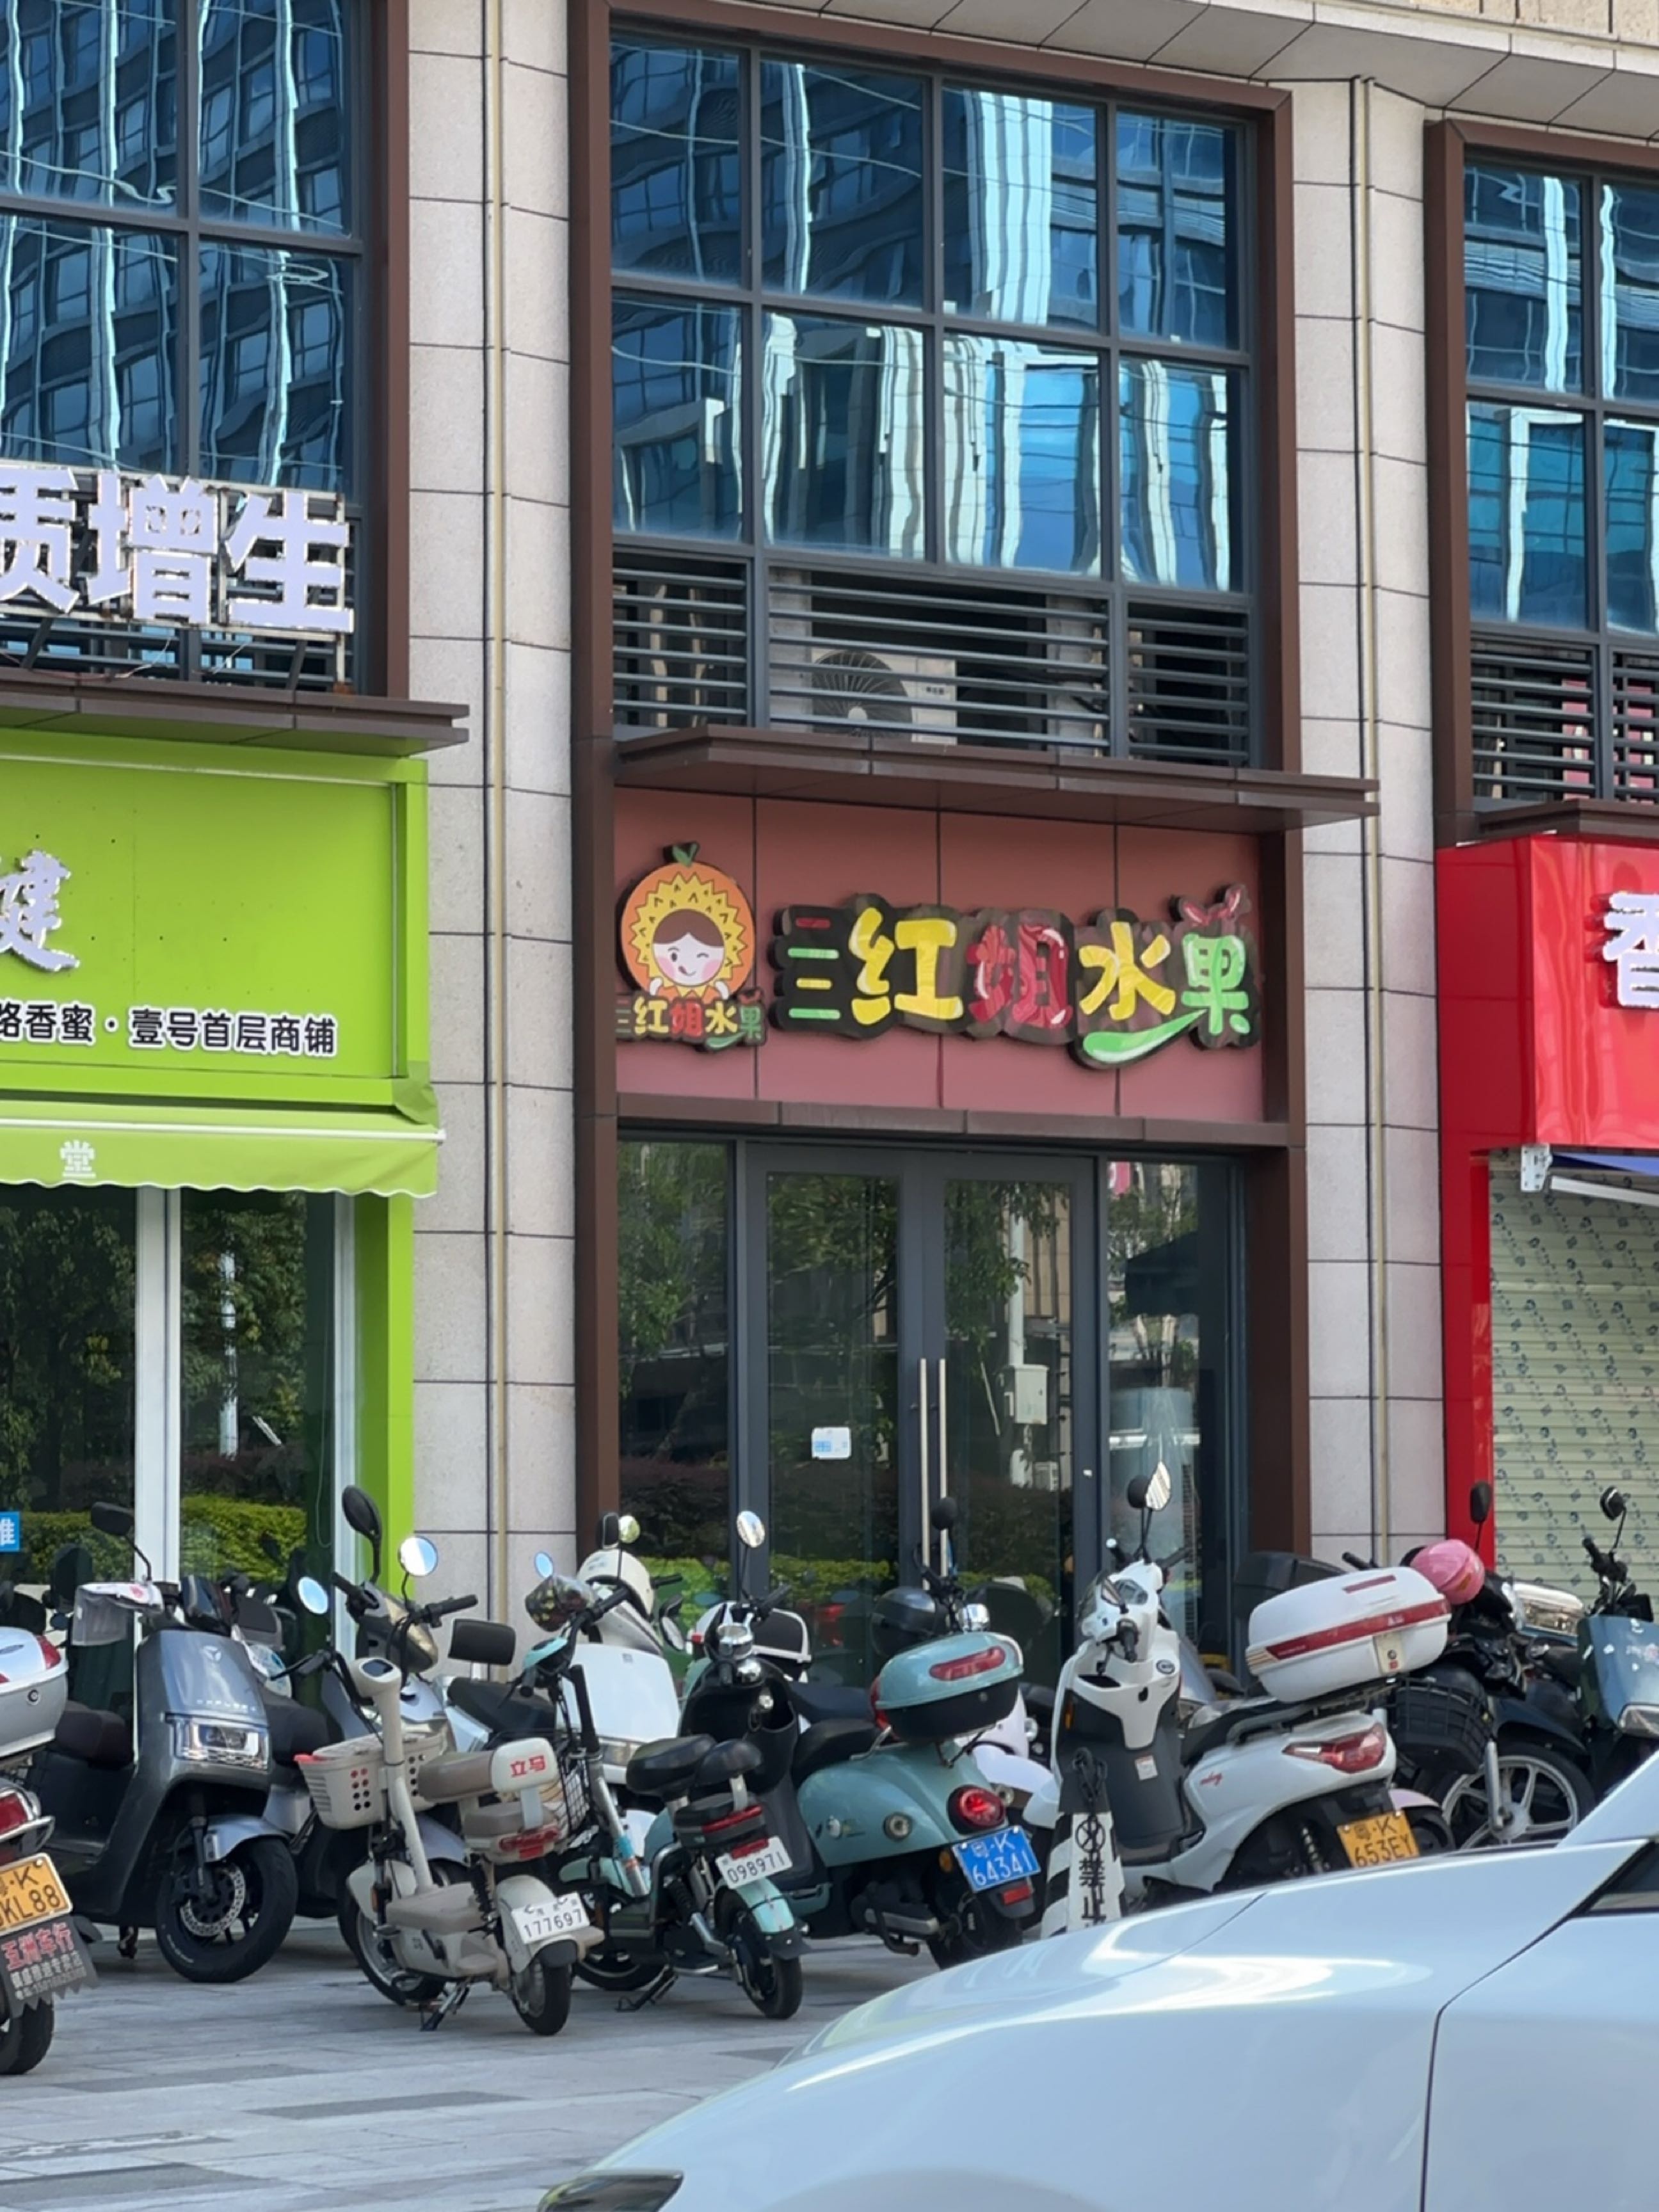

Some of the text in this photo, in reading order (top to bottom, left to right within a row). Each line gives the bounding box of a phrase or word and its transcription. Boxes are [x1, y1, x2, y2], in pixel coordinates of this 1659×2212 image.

[510, 1754, 546, 1777] 立马
[726, 1851, 785, 1884] 098971
[972, 1849, 1033, 1886] 64341
[1354, 1833, 1415, 1868] 653EY
[0, 1884, 61, 1927] KL88
[523, 1909, 583, 1939] 177697
